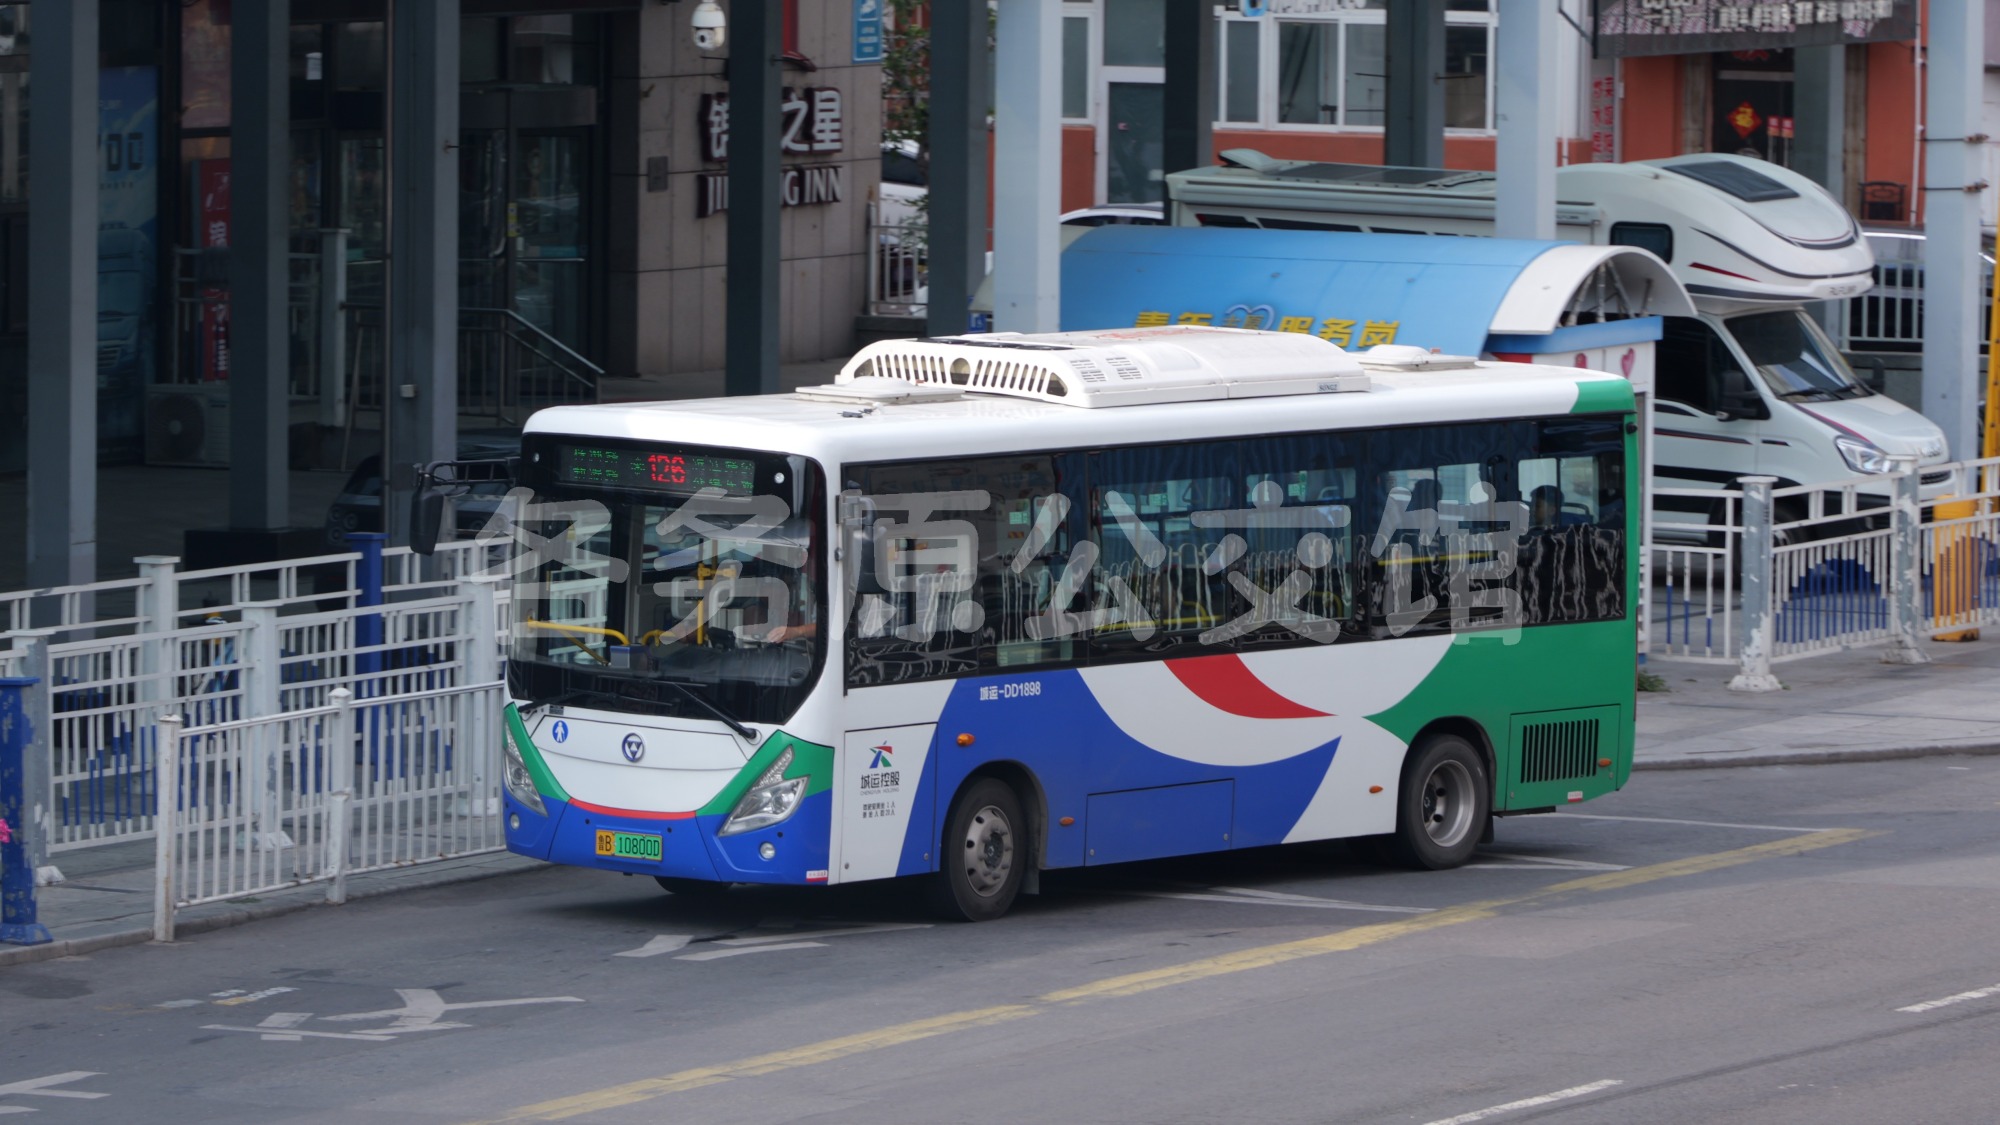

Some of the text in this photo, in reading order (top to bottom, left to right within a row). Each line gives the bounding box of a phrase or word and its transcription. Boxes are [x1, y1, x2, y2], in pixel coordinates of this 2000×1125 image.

[804, 169, 842, 204] INN
[647, 455, 687, 483] 126
[861, 771, 899, 789] 城运控股
